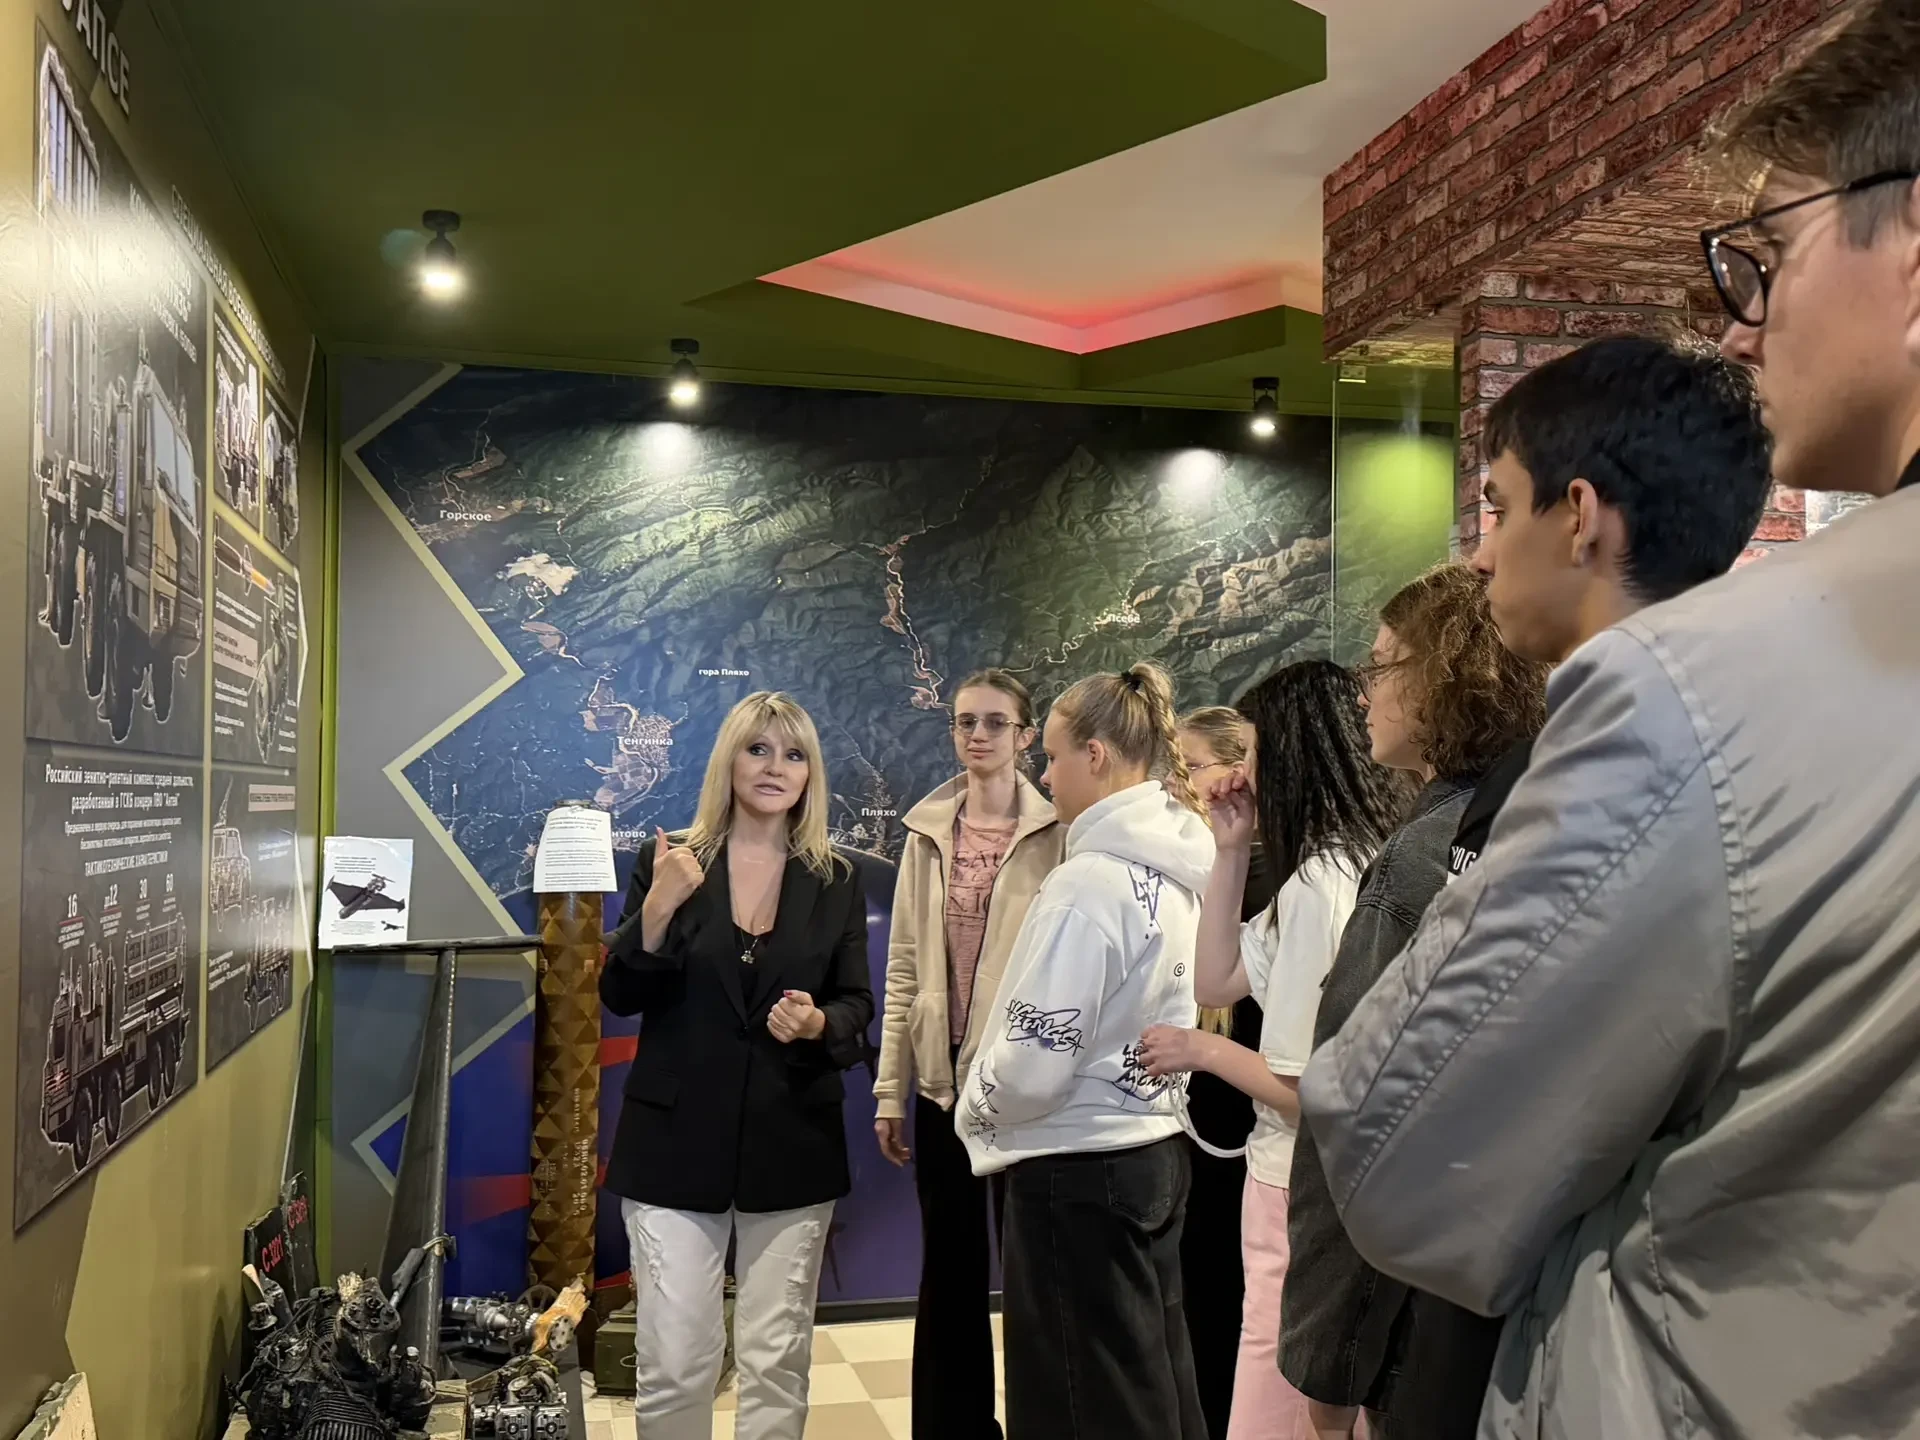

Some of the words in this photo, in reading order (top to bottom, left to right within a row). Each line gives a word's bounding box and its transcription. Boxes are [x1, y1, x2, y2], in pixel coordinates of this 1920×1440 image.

[62, 0, 130, 117] АПСЕ
[440, 509, 492, 521] Горское
[698, 669, 720, 677] гора
[721, 668, 750, 676] Пляхо
[616, 736, 673, 746] Тенгинка
[46, 764, 82, 784] Российский
[861, 807, 897, 817] Пляхо
[611, 830, 647, 839] нтово
[67, 893, 78, 918] 16
